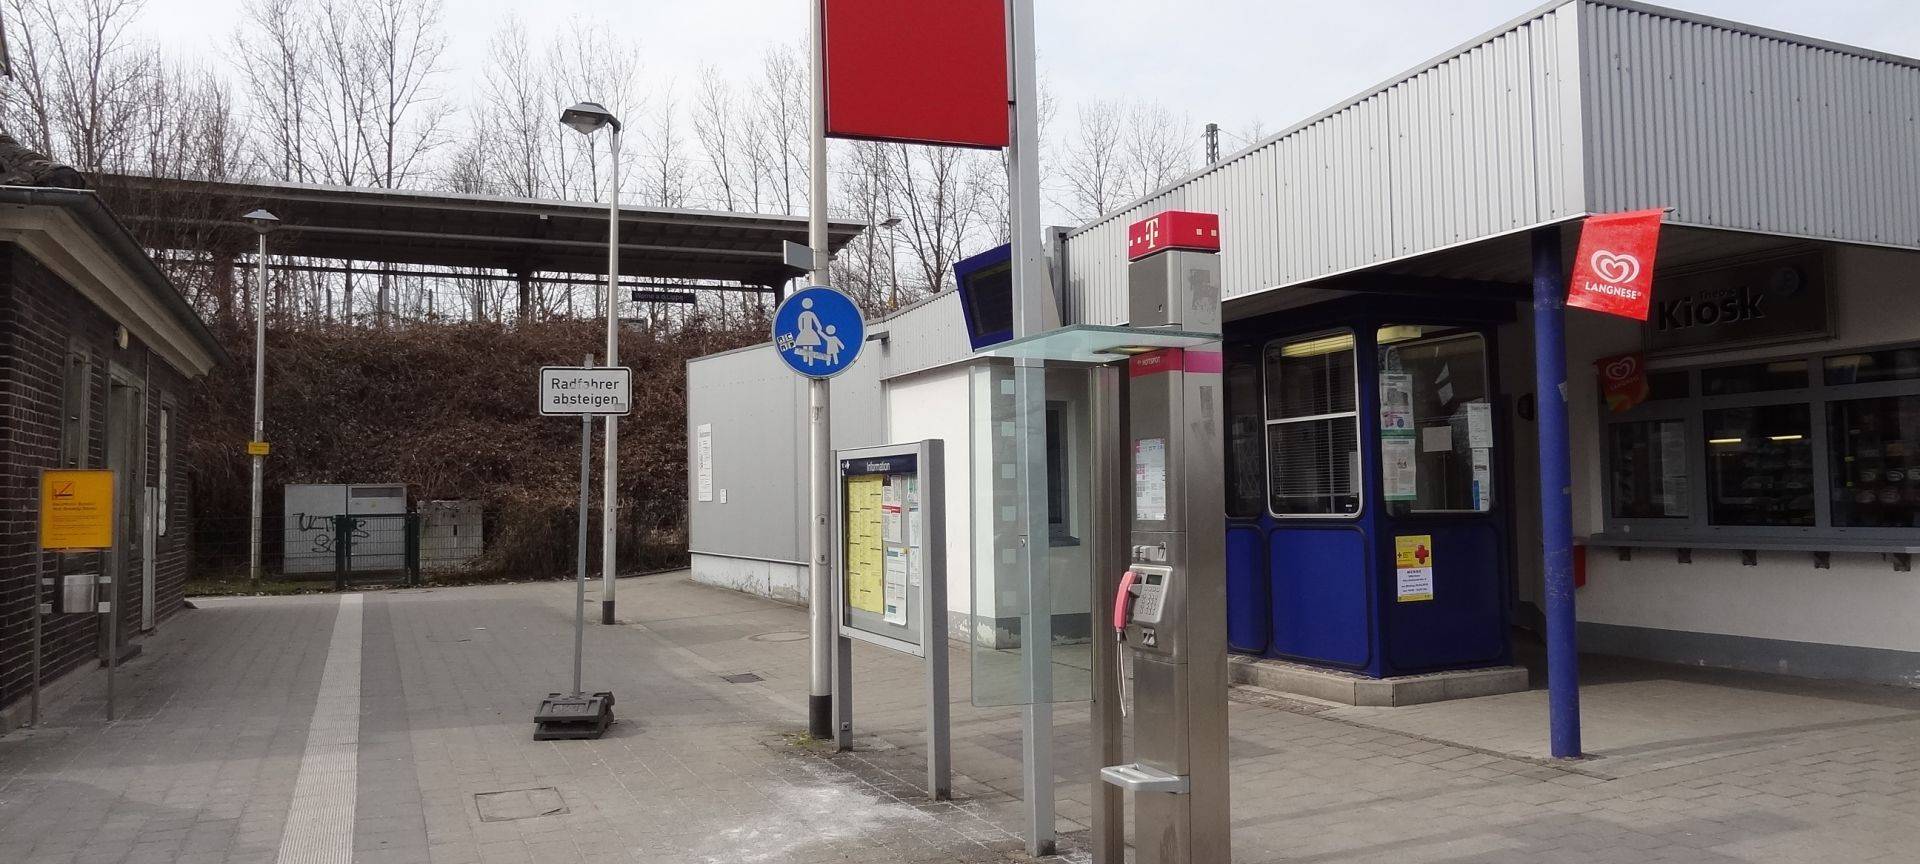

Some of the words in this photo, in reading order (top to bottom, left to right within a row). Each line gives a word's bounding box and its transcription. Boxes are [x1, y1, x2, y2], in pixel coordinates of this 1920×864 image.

[1585, 281, 1637, 300] LANGNESE
[1657, 286, 1766, 332] Kiosk
[551, 377, 620, 390] Radfahrer
[553, 393, 619, 407] absteigen
[866, 461, 891, 472] Information
